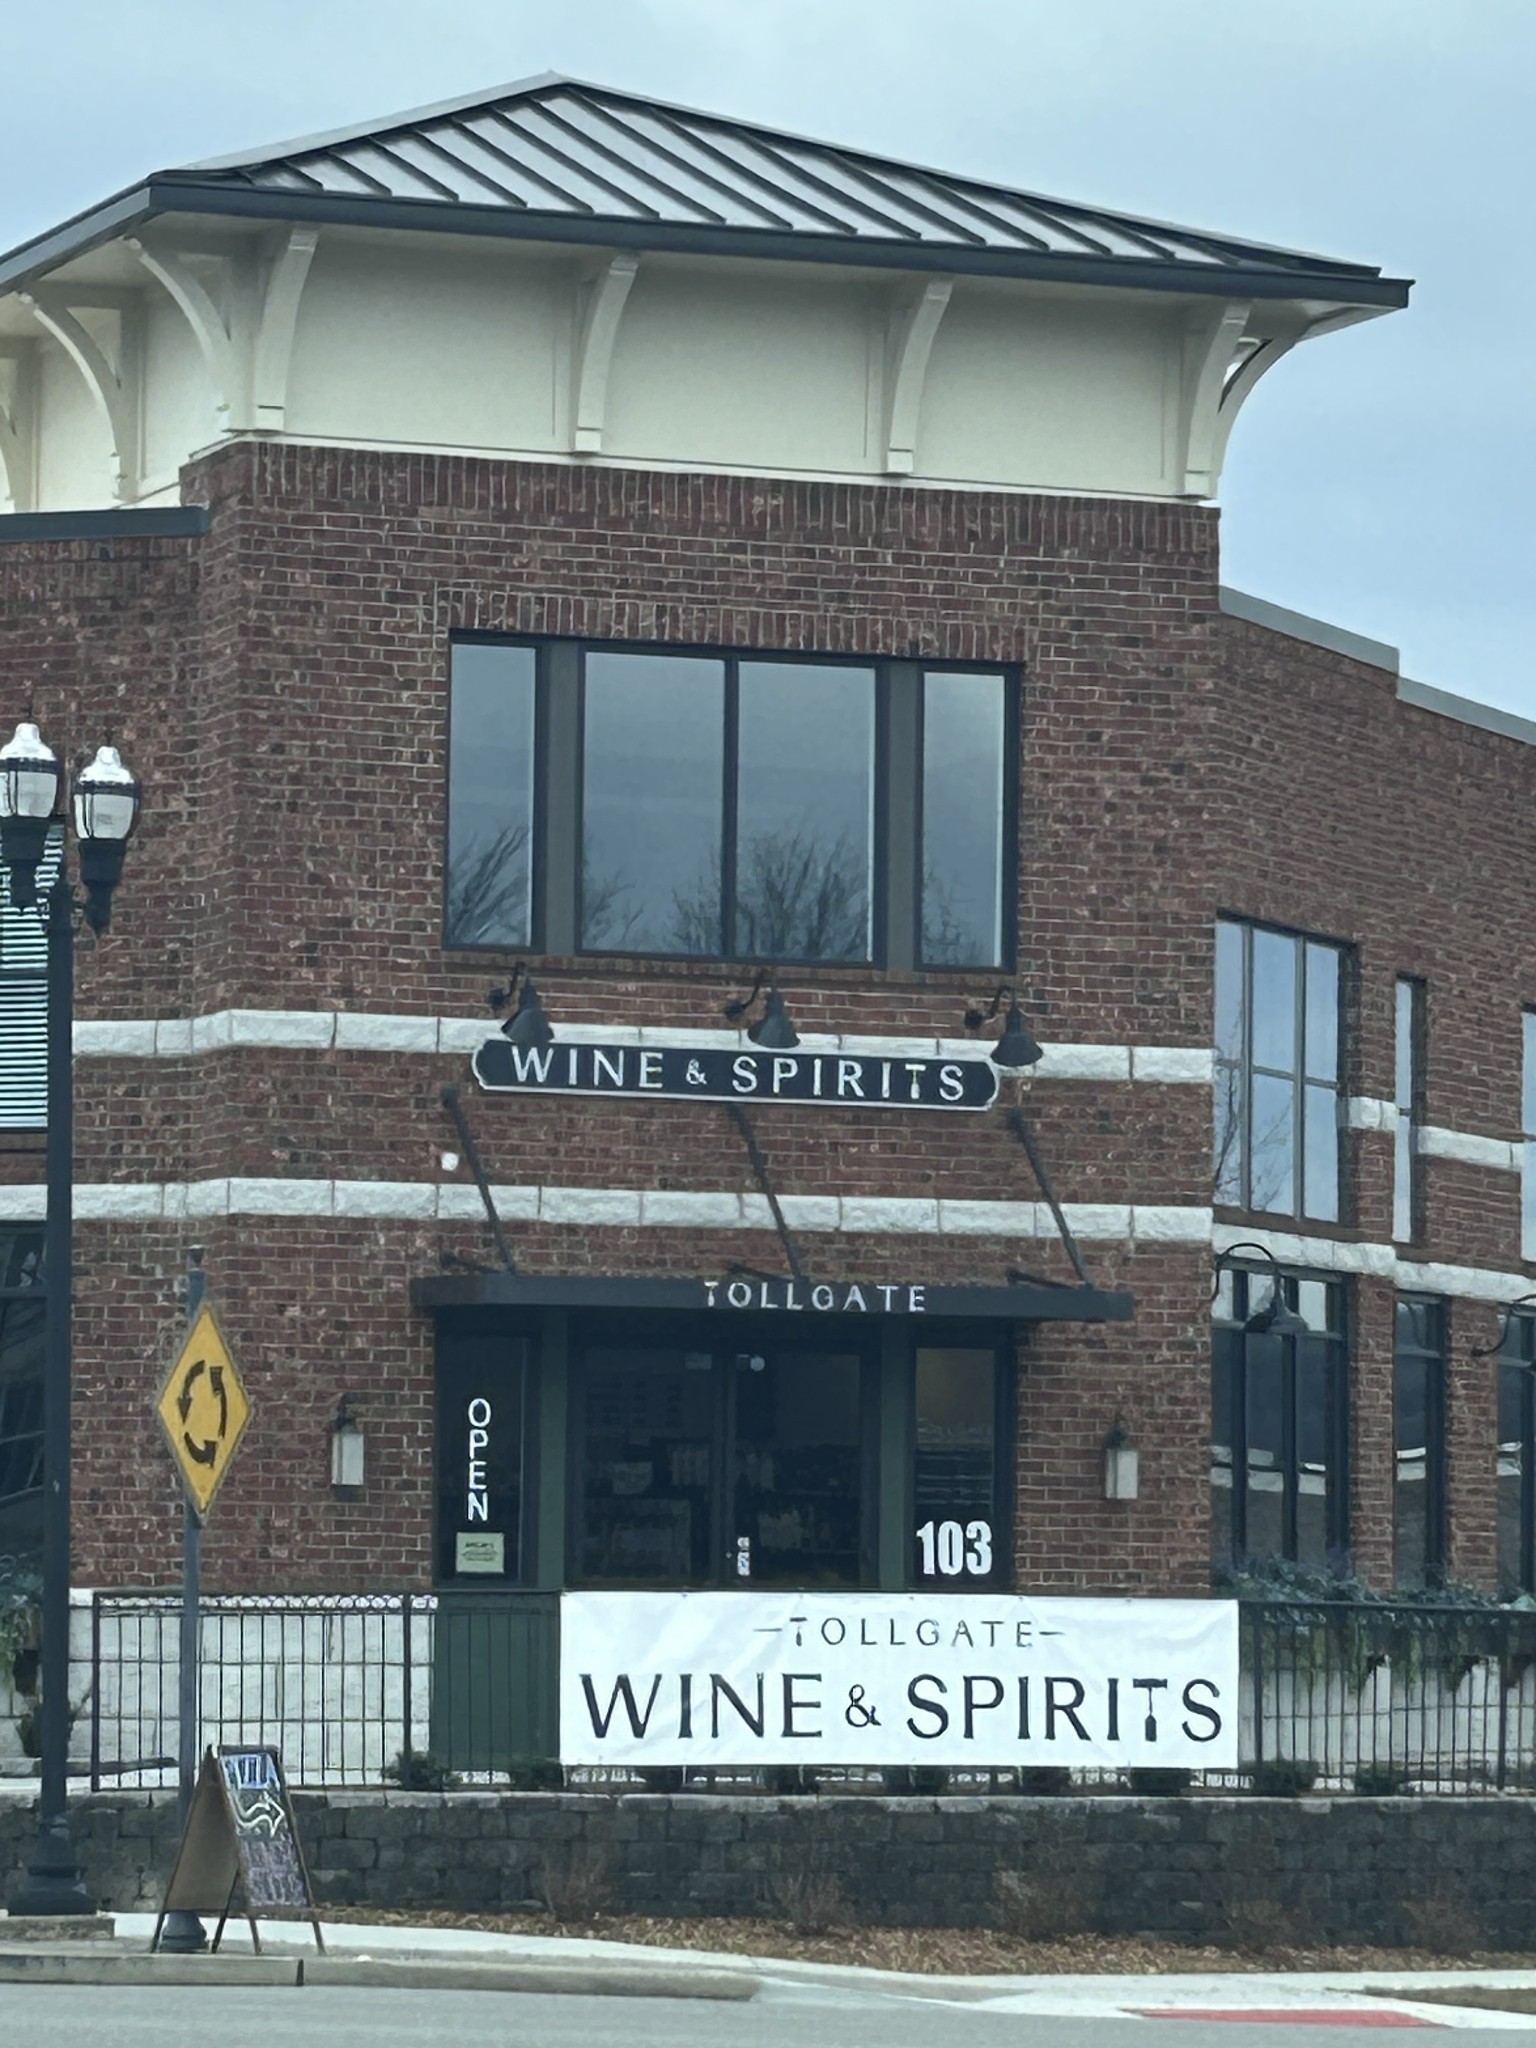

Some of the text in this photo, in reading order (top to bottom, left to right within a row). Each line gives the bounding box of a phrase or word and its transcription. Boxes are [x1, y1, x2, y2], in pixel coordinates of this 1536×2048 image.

[510, 1046, 964, 1101] WINE & SPIRITS
[703, 1281, 926, 1313] TOLLGATE
[467, 1398, 492, 1522] OPEN
[916, 1520, 993, 1576] 103
[788, 1615, 1034, 1649] TOLLGATE
[578, 1672, 1223, 1743] WINE & SPIRITS
